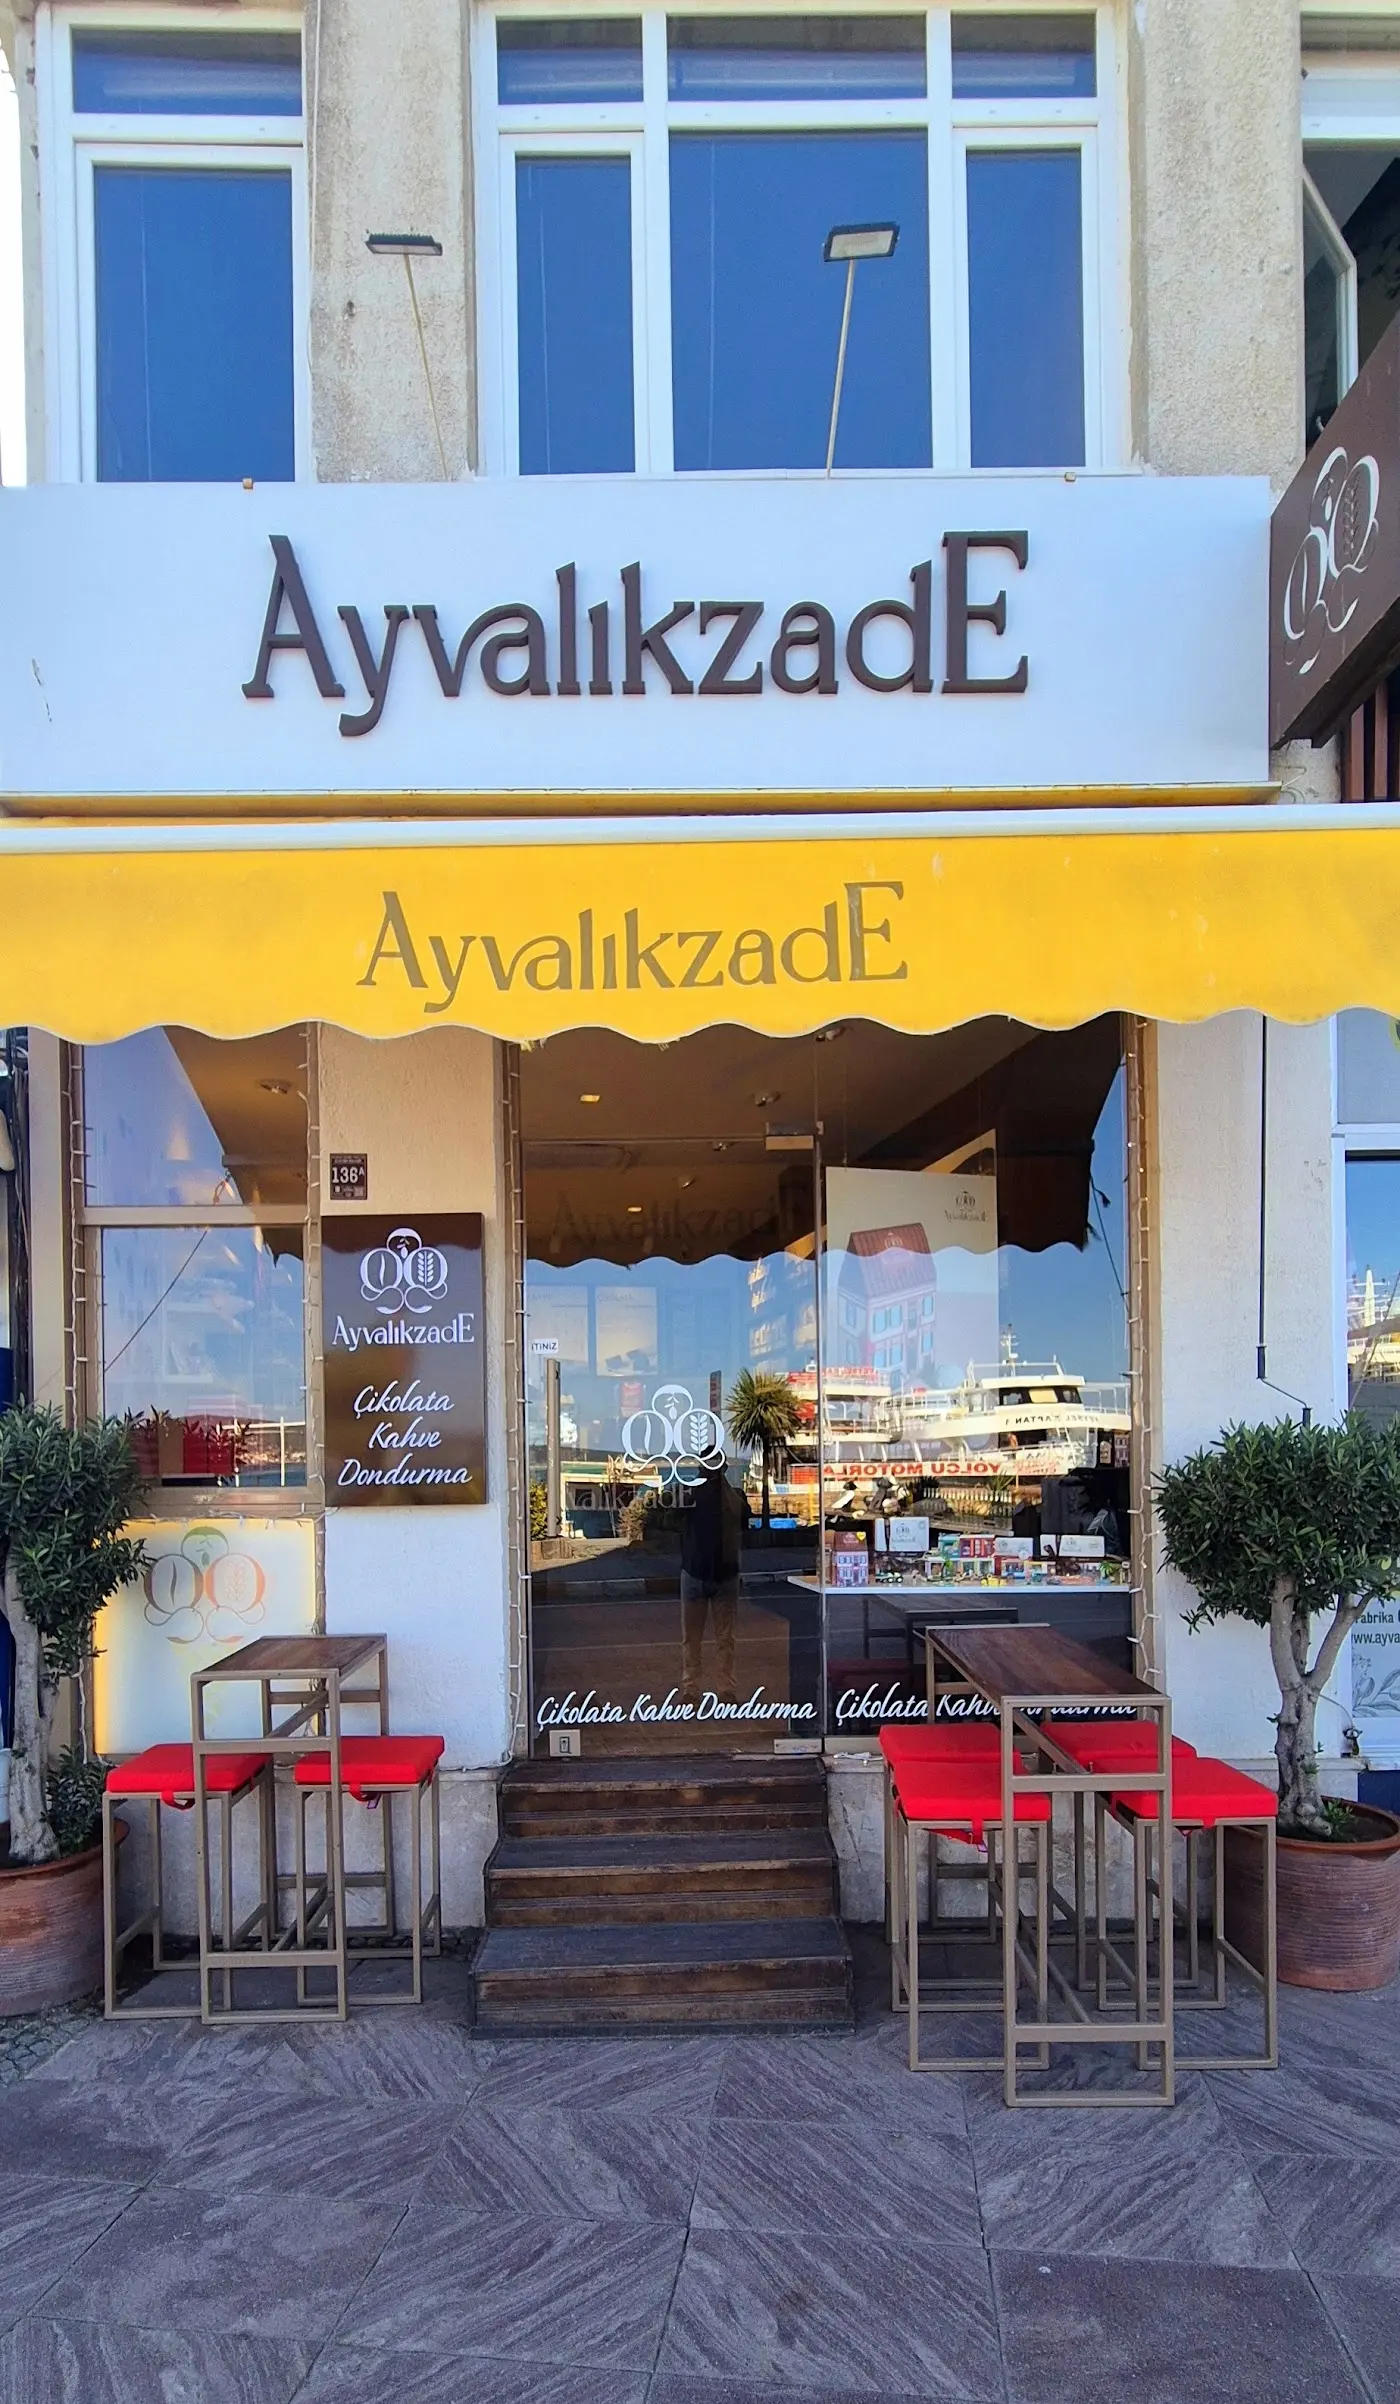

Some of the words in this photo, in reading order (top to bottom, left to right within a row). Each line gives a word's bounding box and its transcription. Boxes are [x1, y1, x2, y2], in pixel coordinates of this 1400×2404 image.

[241, 530, 1029, 737] AyvalıkzadE
[356, 881, 908, 1014] AyvalıkzadE
[332, 1312, 475, 1352] AyvalıkzadE
[353, 1379, 455, 1419] Çikolata
[368, 1416, 443, 1449] Kahve
[337, 1453, 473, 1486] Dondurma
[536, 1690, 628, 1732] Çikolata
[629, 1687, 696, 1722] Kahve
[697, 1686, 818, 1721] Dondurma
[835, 1682, 929, 1727] Çikolata
